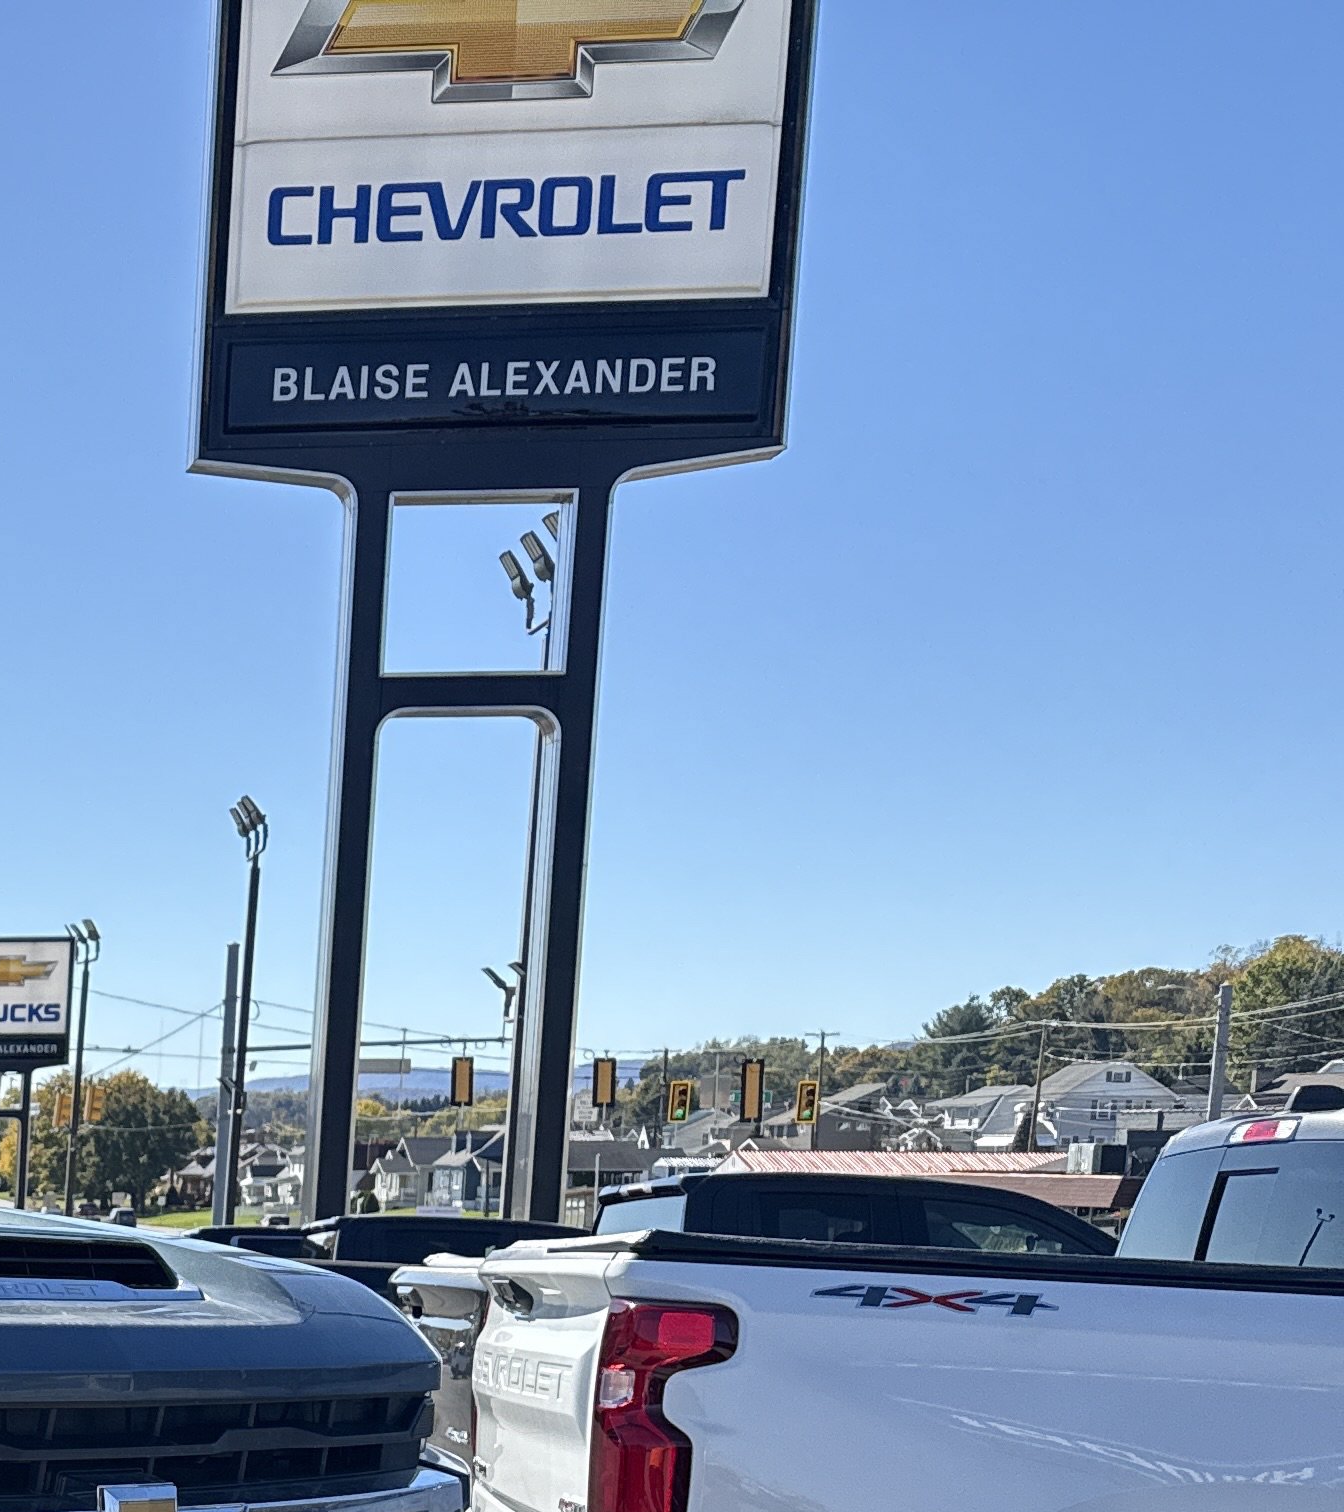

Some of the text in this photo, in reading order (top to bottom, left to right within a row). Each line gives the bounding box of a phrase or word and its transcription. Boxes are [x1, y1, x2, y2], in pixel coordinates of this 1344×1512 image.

[267, 168, 746, 246] CHEVROLET
[272, 356, 717, 402] BLAISE ALEXANDER
